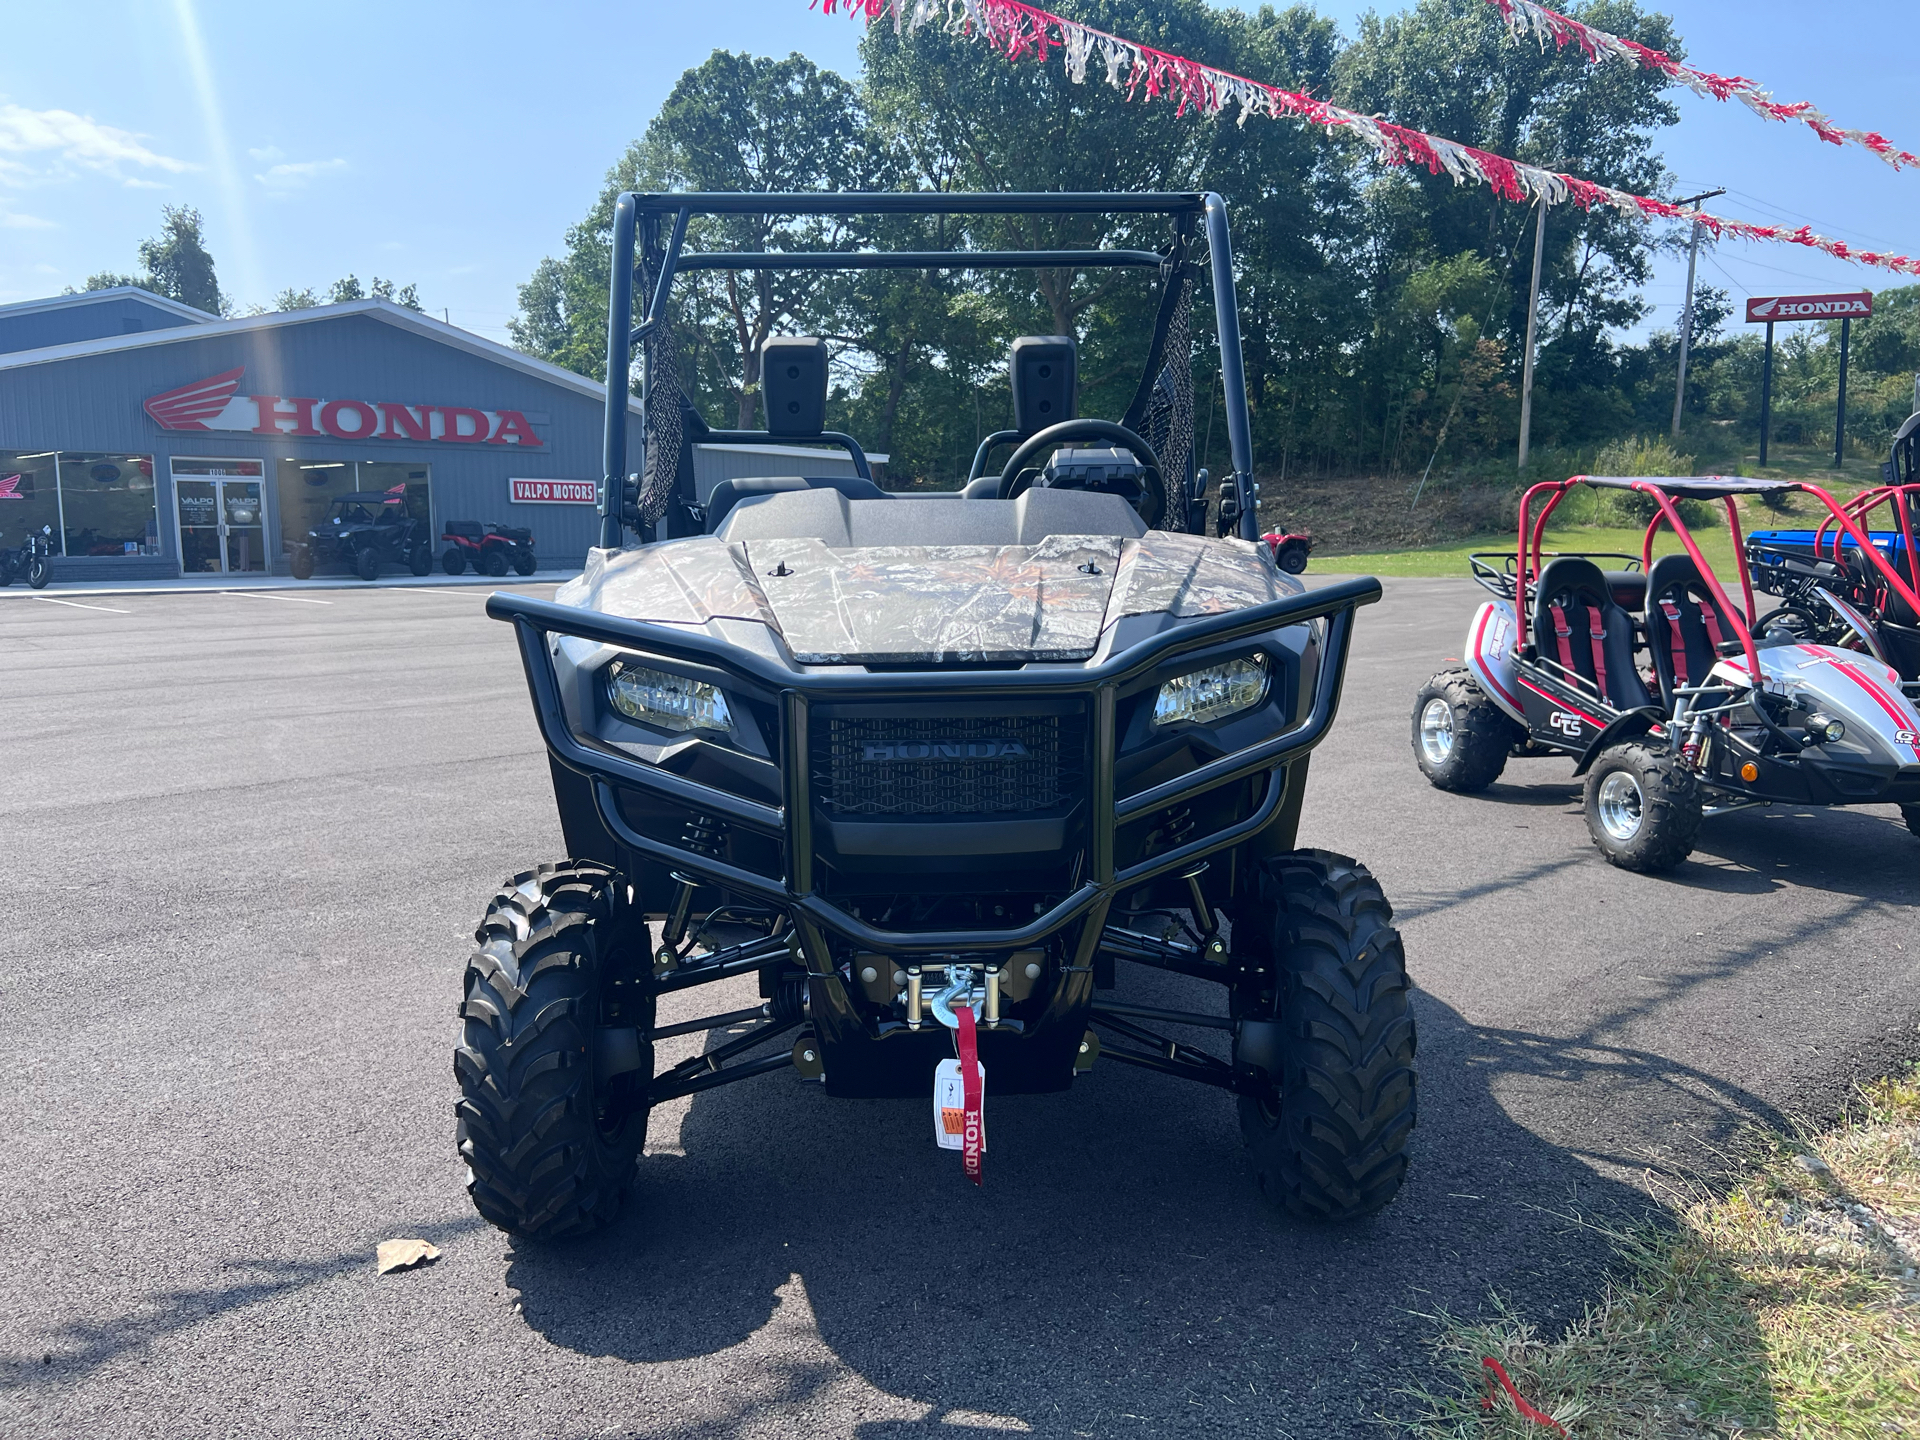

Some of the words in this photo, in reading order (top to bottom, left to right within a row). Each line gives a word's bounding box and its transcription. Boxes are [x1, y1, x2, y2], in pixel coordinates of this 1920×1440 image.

[1778, 301, 1869, 315] HONDA
[250, 395, 543, 446] HONDA
[226, 497, 258, 505] VALPO
[517, 483, 550, 499] VALPO
[553, 484, 593, 500] MOTORS
[1550, 711, 1582, 737] GTS
[863, 740, 1031, 761] HONDA
[965, 1109, 979, 1175] HONDA
